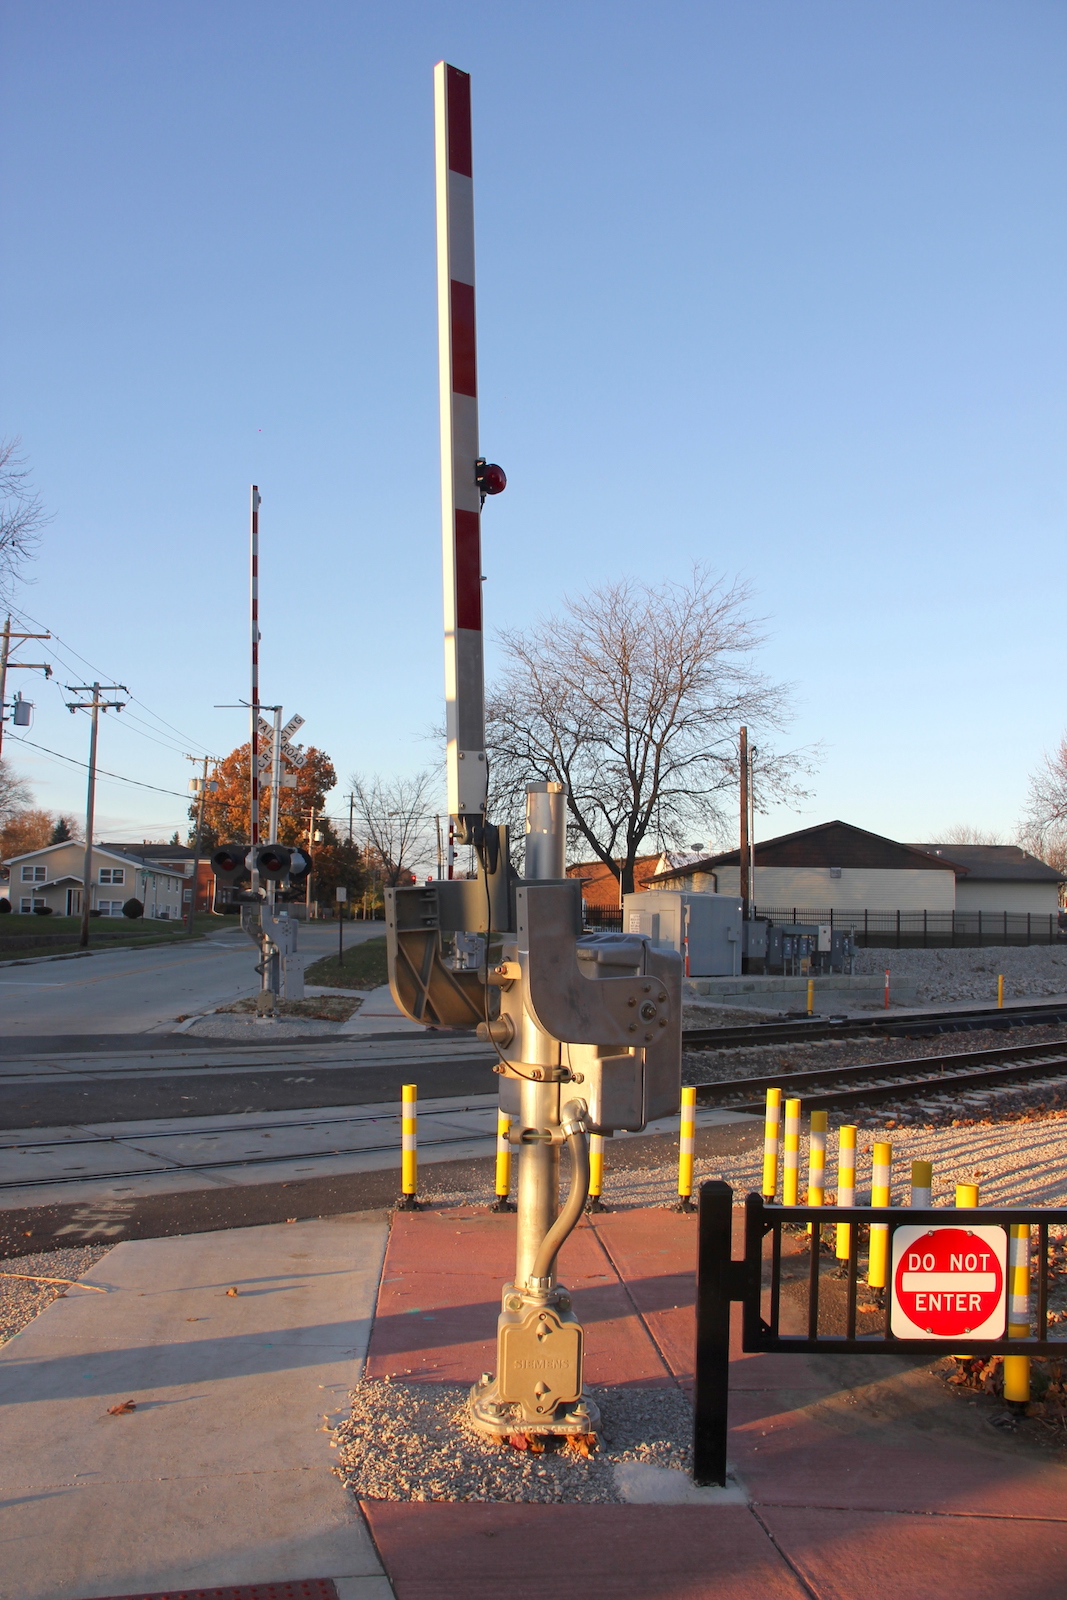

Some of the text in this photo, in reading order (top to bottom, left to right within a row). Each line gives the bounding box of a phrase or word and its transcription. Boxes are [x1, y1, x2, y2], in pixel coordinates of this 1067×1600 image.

[257, 716, 303, 768] CROSING
[908, 1253, 990, 1271] DO NOT
[915, 1293, 981, 1311] ENTER
[513, 1360, 570, 1369] SIEMENS
